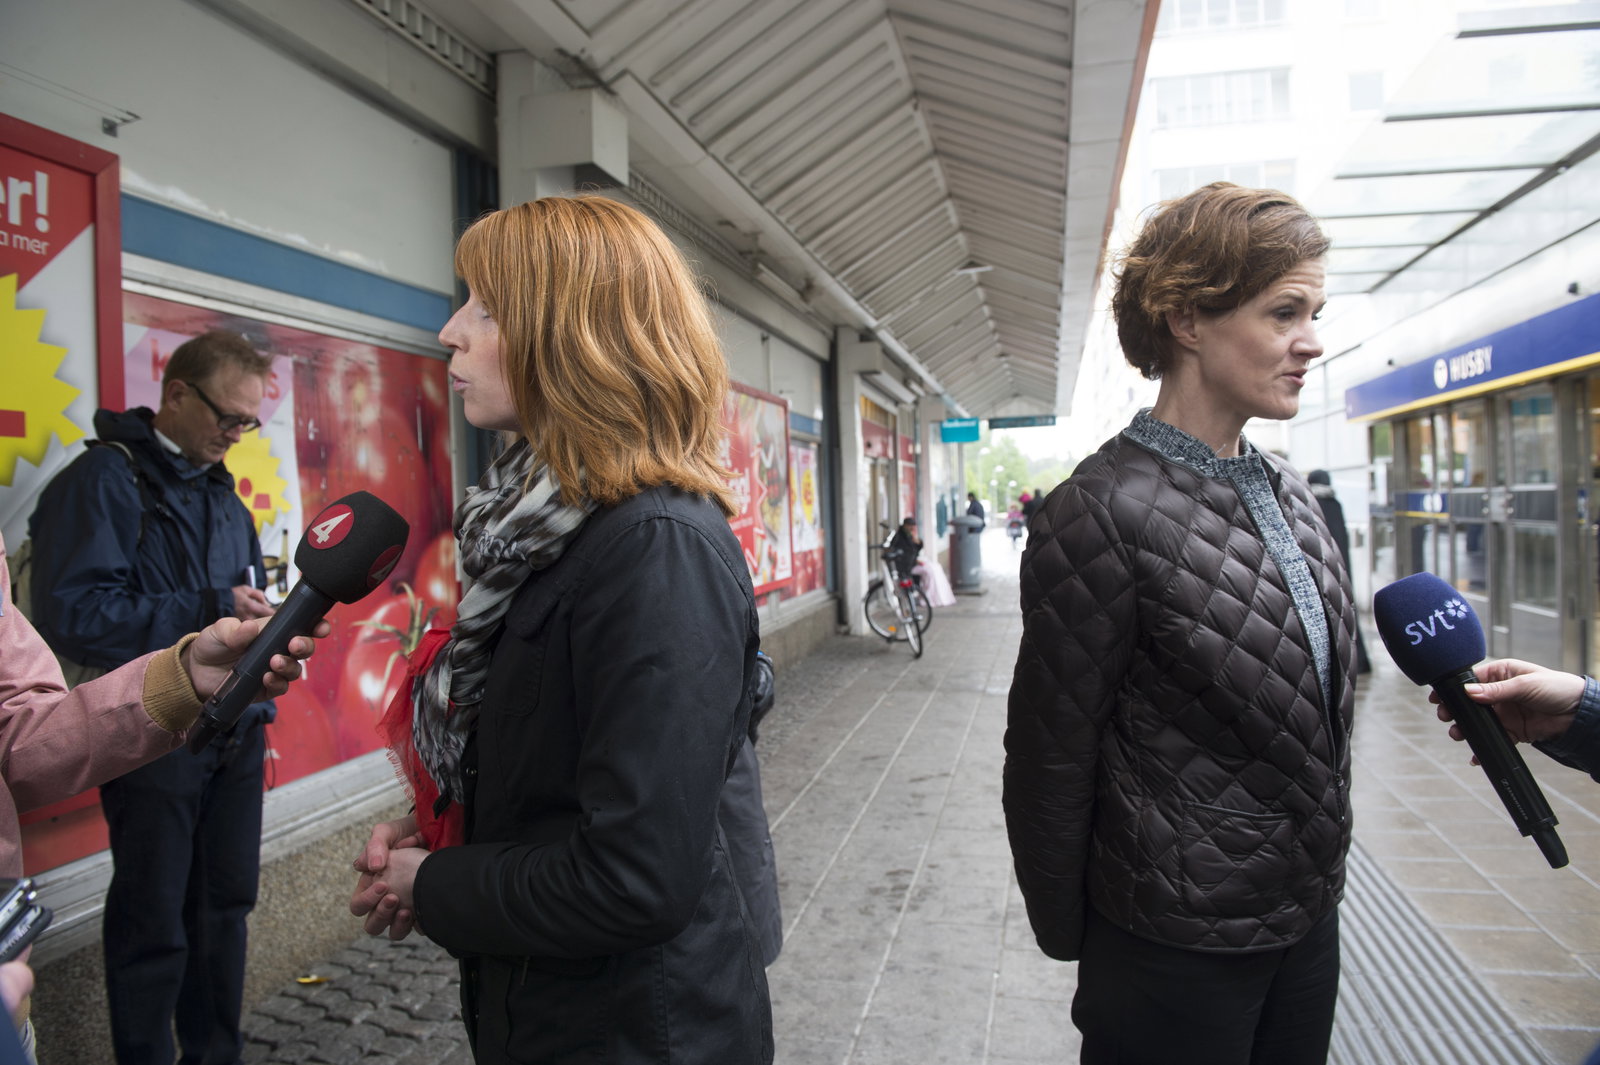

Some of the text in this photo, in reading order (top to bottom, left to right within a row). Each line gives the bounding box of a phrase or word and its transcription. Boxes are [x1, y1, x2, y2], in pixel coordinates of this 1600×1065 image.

[12, 233, 50, 255] mer
[1449, 345, 1493, 383] HUSBY
[312, 511, 352, 544] 4
[1405, 609, 1455, 645] svt
